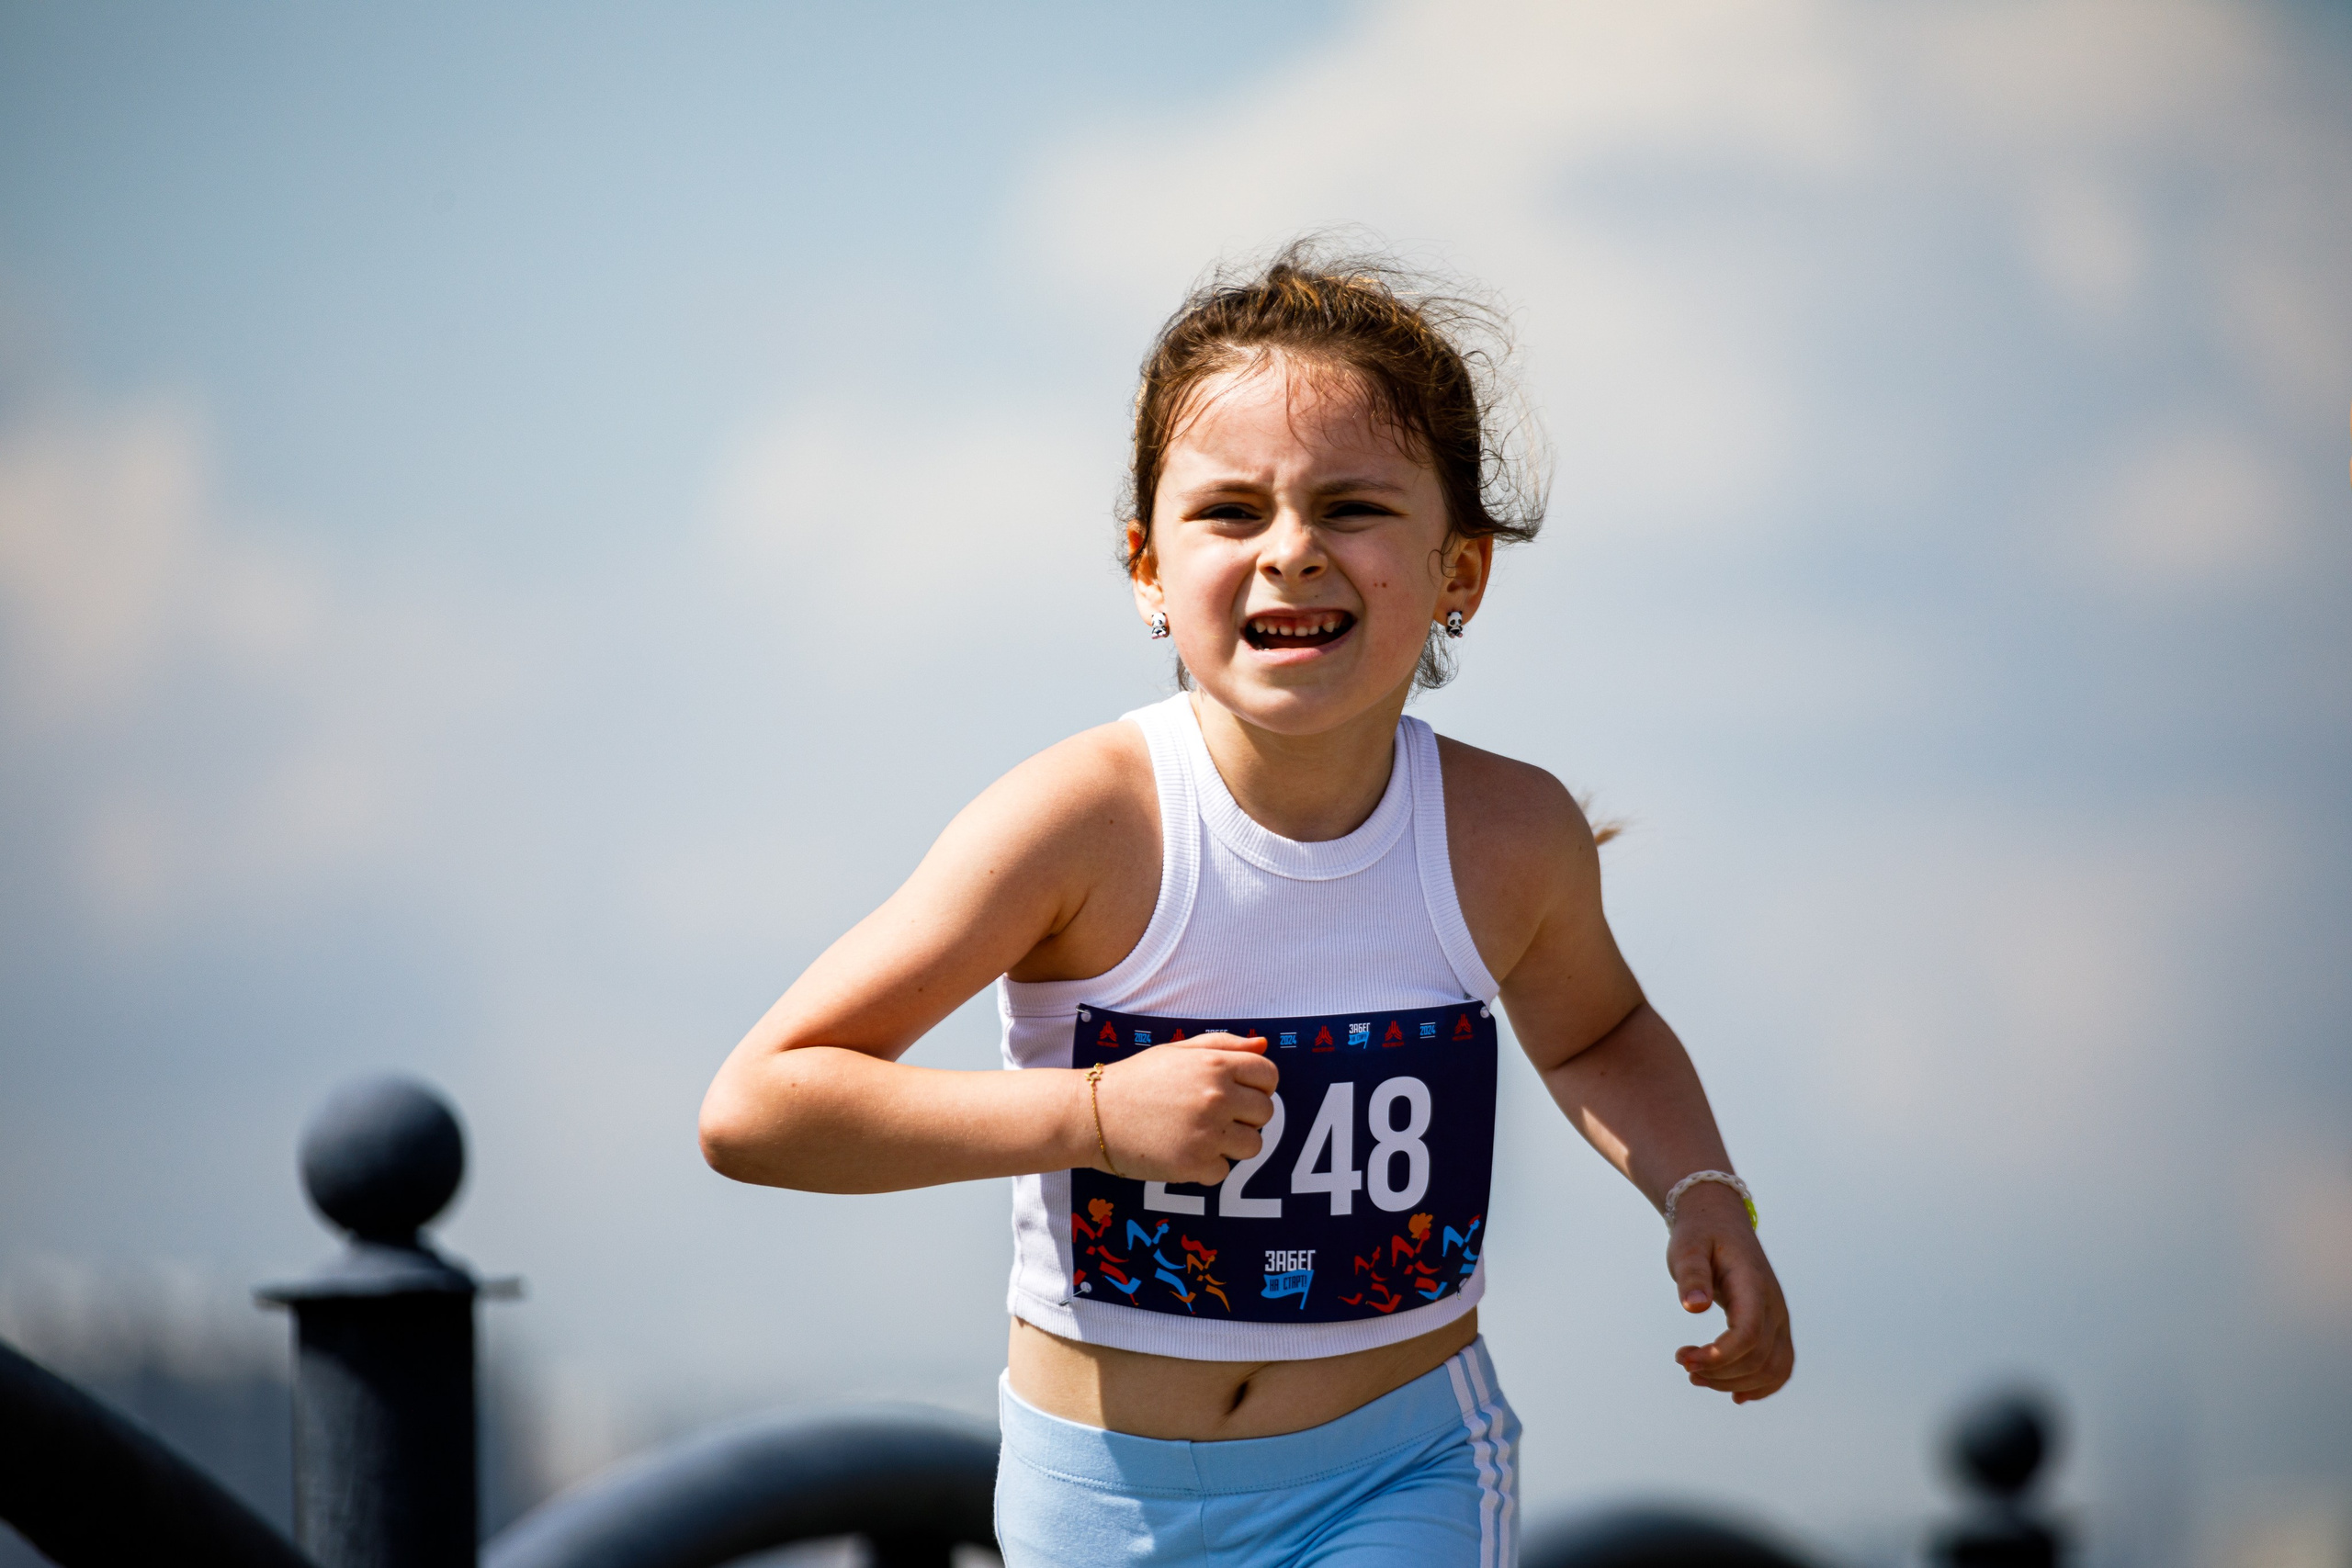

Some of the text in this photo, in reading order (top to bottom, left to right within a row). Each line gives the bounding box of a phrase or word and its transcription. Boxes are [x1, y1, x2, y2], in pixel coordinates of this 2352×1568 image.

[1349, 1022, 1371, 1033] ЗАБЕГ
[1419, 1025, 1436, 1035] 2024
[1134, 1032, 1151, 1043] 2024
[1280, 1035, 1296, 1045] 2024
[1144, 1076, 1431, 1218] 248
[1264, 1249, 1316, 1272] ЗАБЕГ
[1269, 1275, 1307, 1292] НА СТАРТ!
